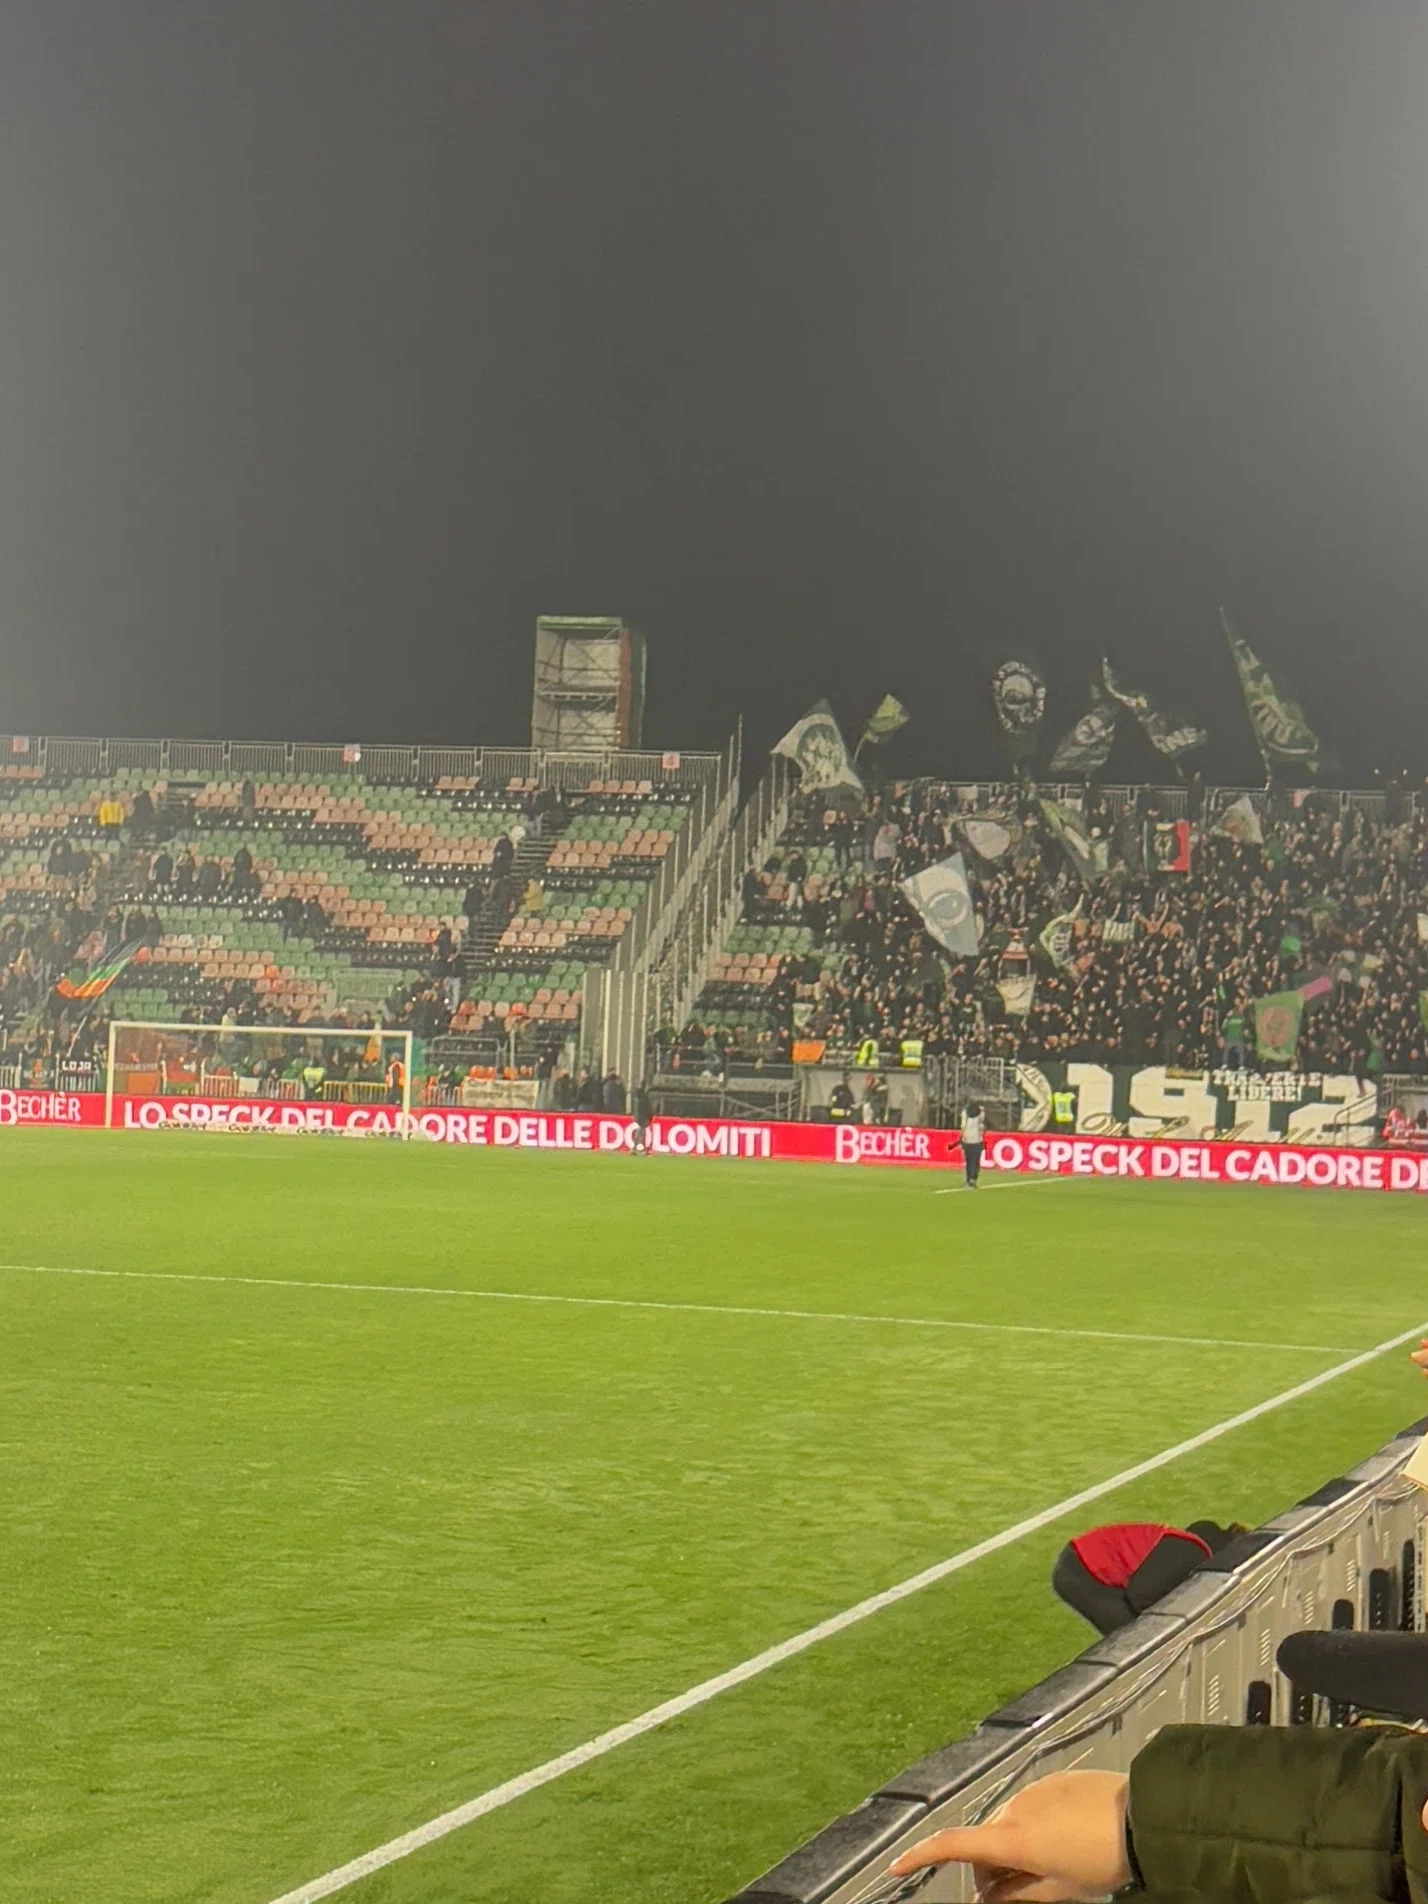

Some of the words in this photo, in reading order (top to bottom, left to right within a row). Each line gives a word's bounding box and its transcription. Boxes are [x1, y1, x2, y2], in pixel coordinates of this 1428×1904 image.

[123, 1100, 167, 1130] LO
[171, 1102, 278, 1130] SPECK
[281, 1107, 341, 1133] DEL
[344, 1109, 488, 1145] CADORE
[493, 1114, 593, 1149] DELLE
[598, 1120, 771, 1158] DOLOMITI
[979, 1137, 1023, 1169] LO
[1028, 1140, 1145, 1177] SPECK
[1151, 1147, 1219, 1179] DEL
[1224, 1150, 1384, 1188] CADORE
